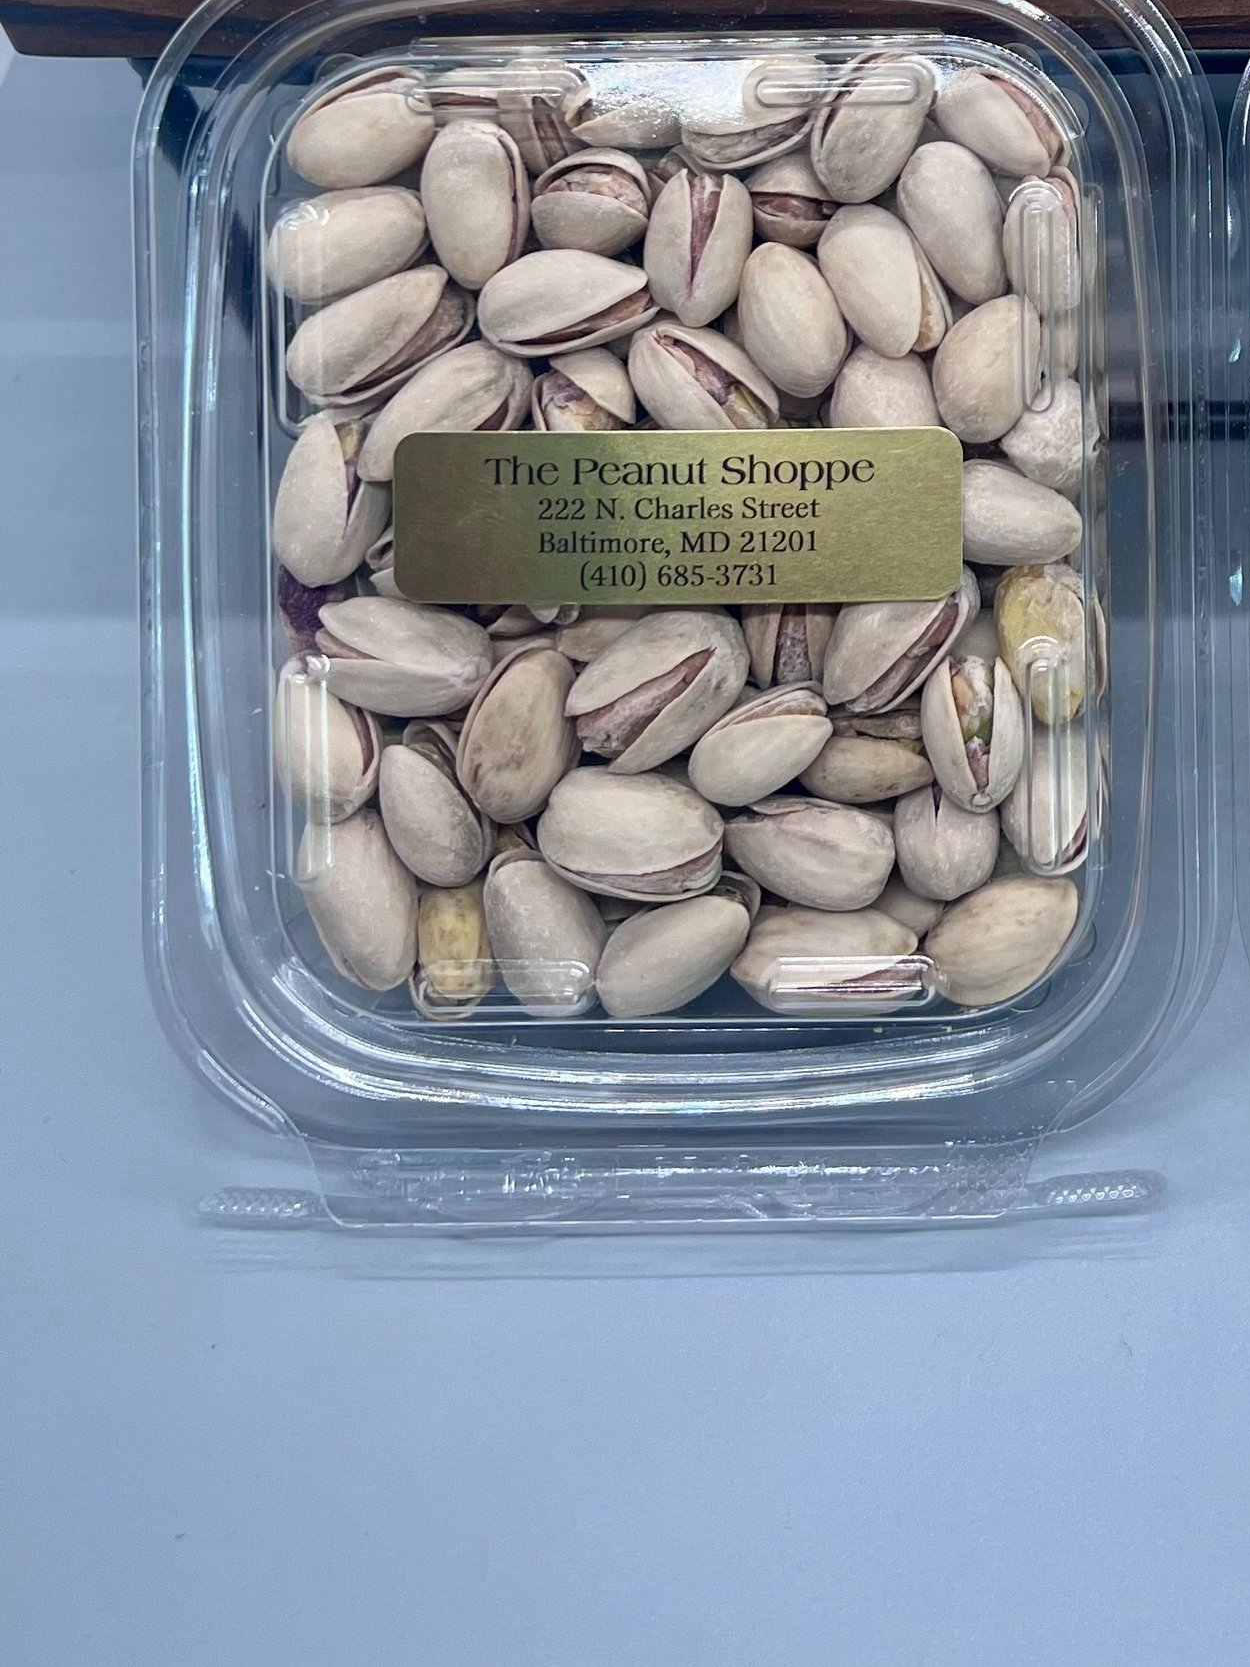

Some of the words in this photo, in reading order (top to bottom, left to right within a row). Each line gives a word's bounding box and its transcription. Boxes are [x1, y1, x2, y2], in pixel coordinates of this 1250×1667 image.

[484, 455, 560, 486] The
[572, 457, 709, 486] Peanut
[720, 453, 875, 492] Shoppe
[538, 497, 586, 521] 222
[594, 497, 625, 521] N.
[634, 495, 734, 521] Charles
[741, 496, 821, 520] Street
[538, 530, 671, 560] Baltimore,
[679, 530, 731, 554] MD
[739, 529, 817, 554] 21201
[580, 560, 647, 592] (410)
[657, 563, 778, 587] 685-3731
